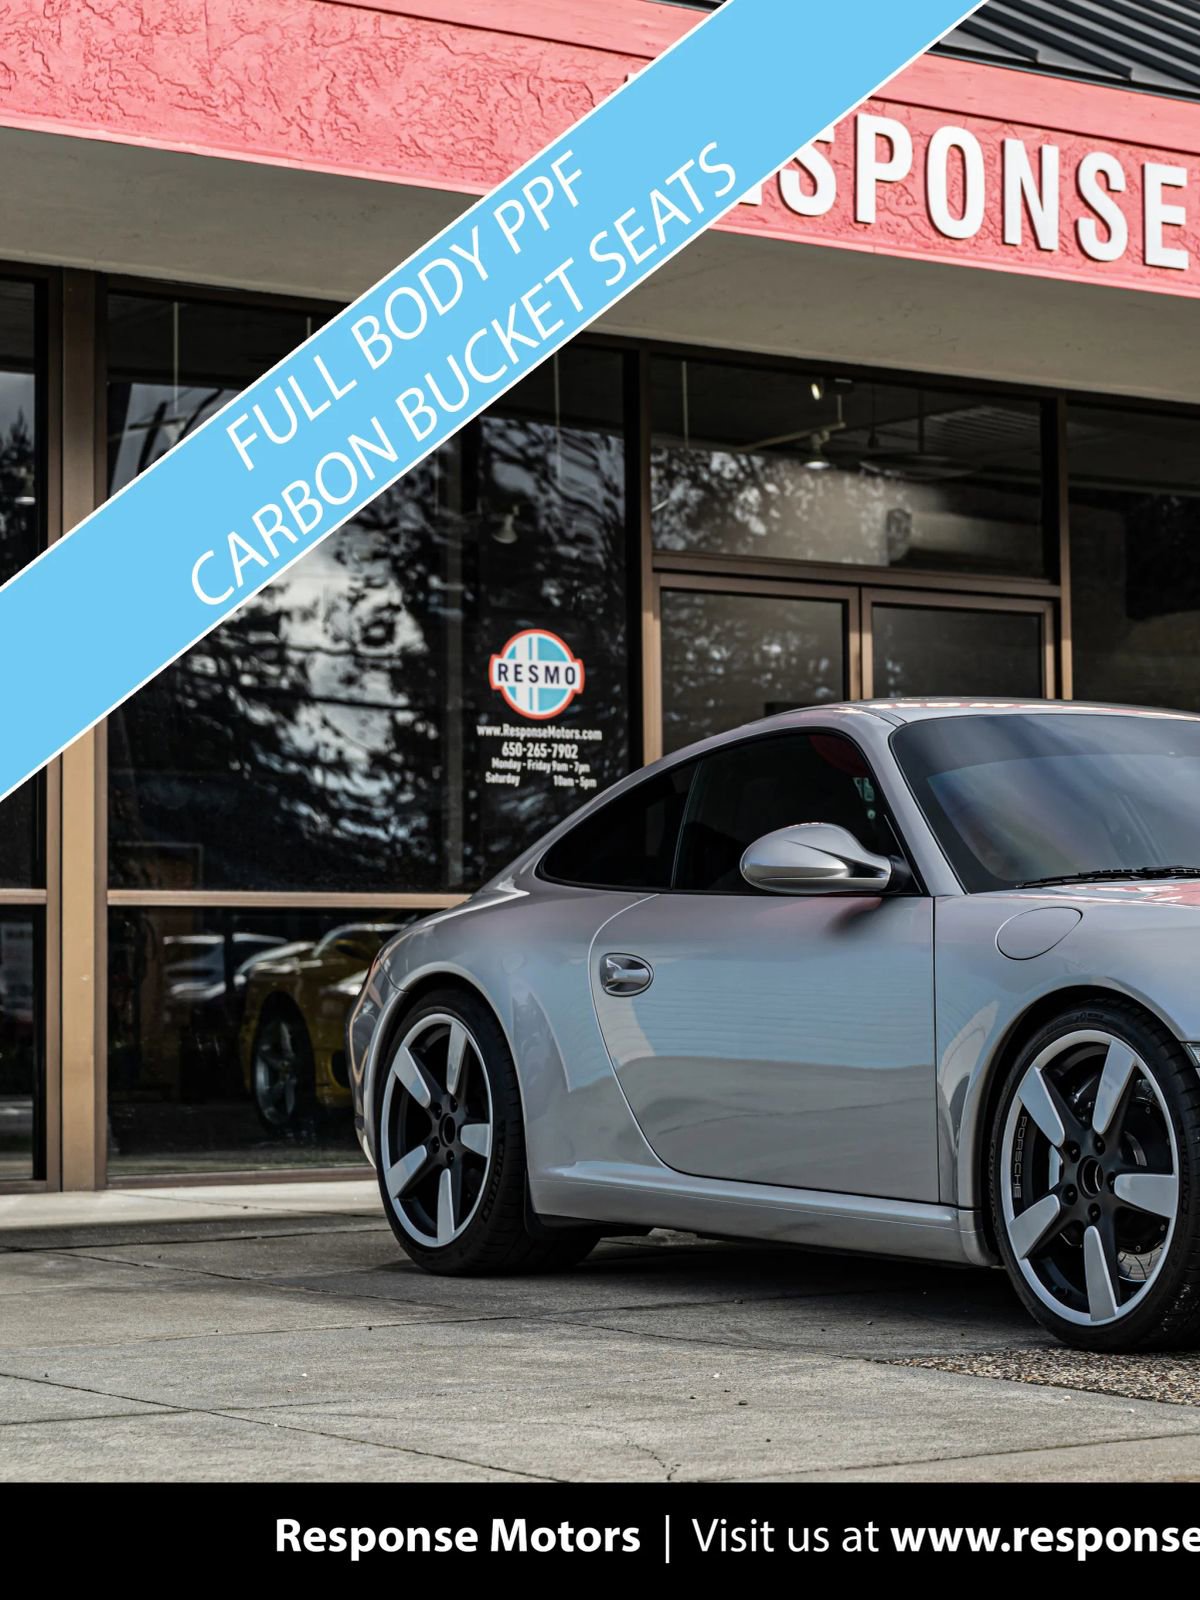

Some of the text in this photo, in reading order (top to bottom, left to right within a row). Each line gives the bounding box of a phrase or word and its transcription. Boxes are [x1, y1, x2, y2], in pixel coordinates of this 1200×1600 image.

[738, 112, 1191, 272] SPONSE
[498, 663, 576, 685] RESMO
[476, 724, 602, 740] www.ResponseMotors.com
[502, 742, 578, 758] 650-265-7902
[491, 757, 521, 772] Monday
[527, 759, 551, 774] Friday
[551, 760, 569, 772] 9am
[574, 761, 590, 774] 7pm
[485, 772, 520, 786] Saturday
[553, 774, 575, 787] 10am
[579, 776, 597, 789] 5pm
[1013, 1115, 1028, 1199] PORSCHE
